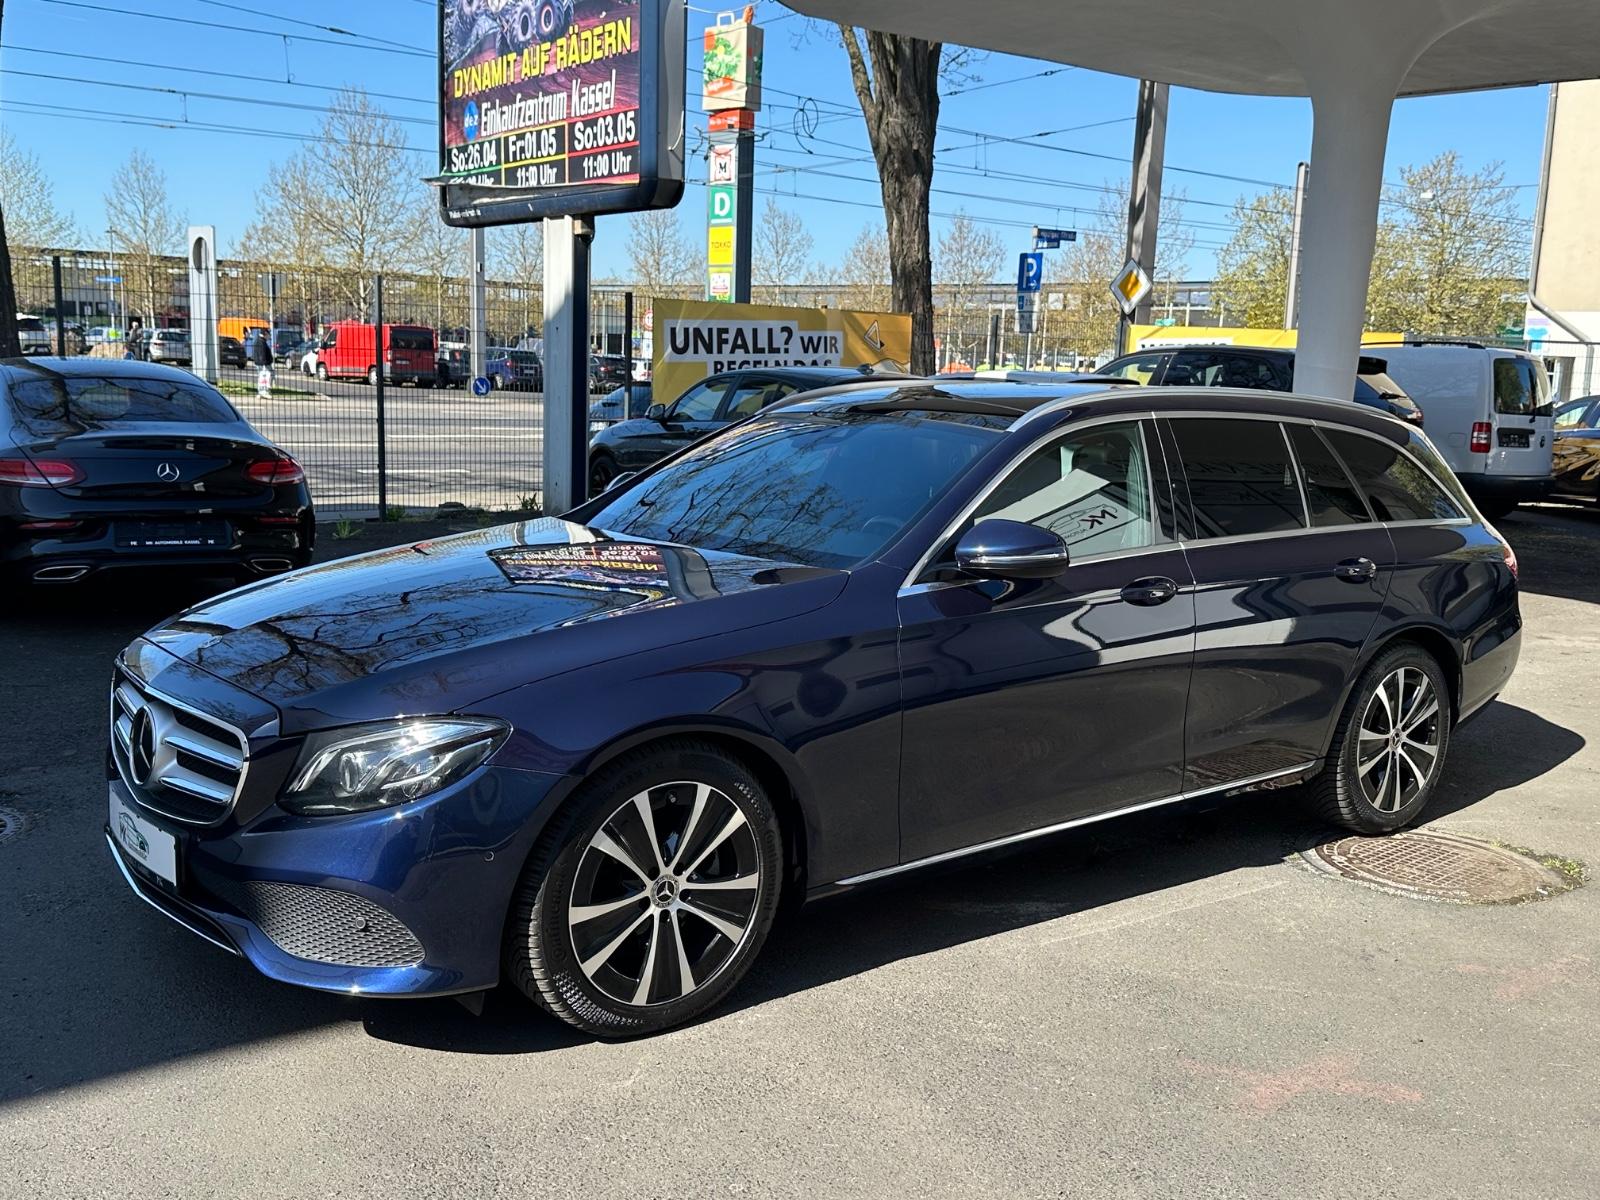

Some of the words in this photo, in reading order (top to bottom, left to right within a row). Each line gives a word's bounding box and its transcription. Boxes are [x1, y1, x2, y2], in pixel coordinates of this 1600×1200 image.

[454, 53, 517, 98] DYNAMIT
[521, 42, 551, 79] AUF
[556, 17, 631, 69] RÄDERN
[481, 91, 567, 137] Einkaufzentrum
[571, 69, 616, 117] Kassel
[508, 128, 557, 162] Fr:01.05
[574, 110, 636, 151] So:03.05
[451, 140, 497, 173] So:26.04
[583, 154, 609, 179] 11:00
[611, 151, 632, 175] Uhr
[718, 162, 727, 174] M
[540, 164, 557, 185] Uhr
[714, 192, 731, 216] D
[1022, 257, 1038, 288] P
[669, 326, 793, 355] UNFALL?
[799, 335, 839, 353] WIR
